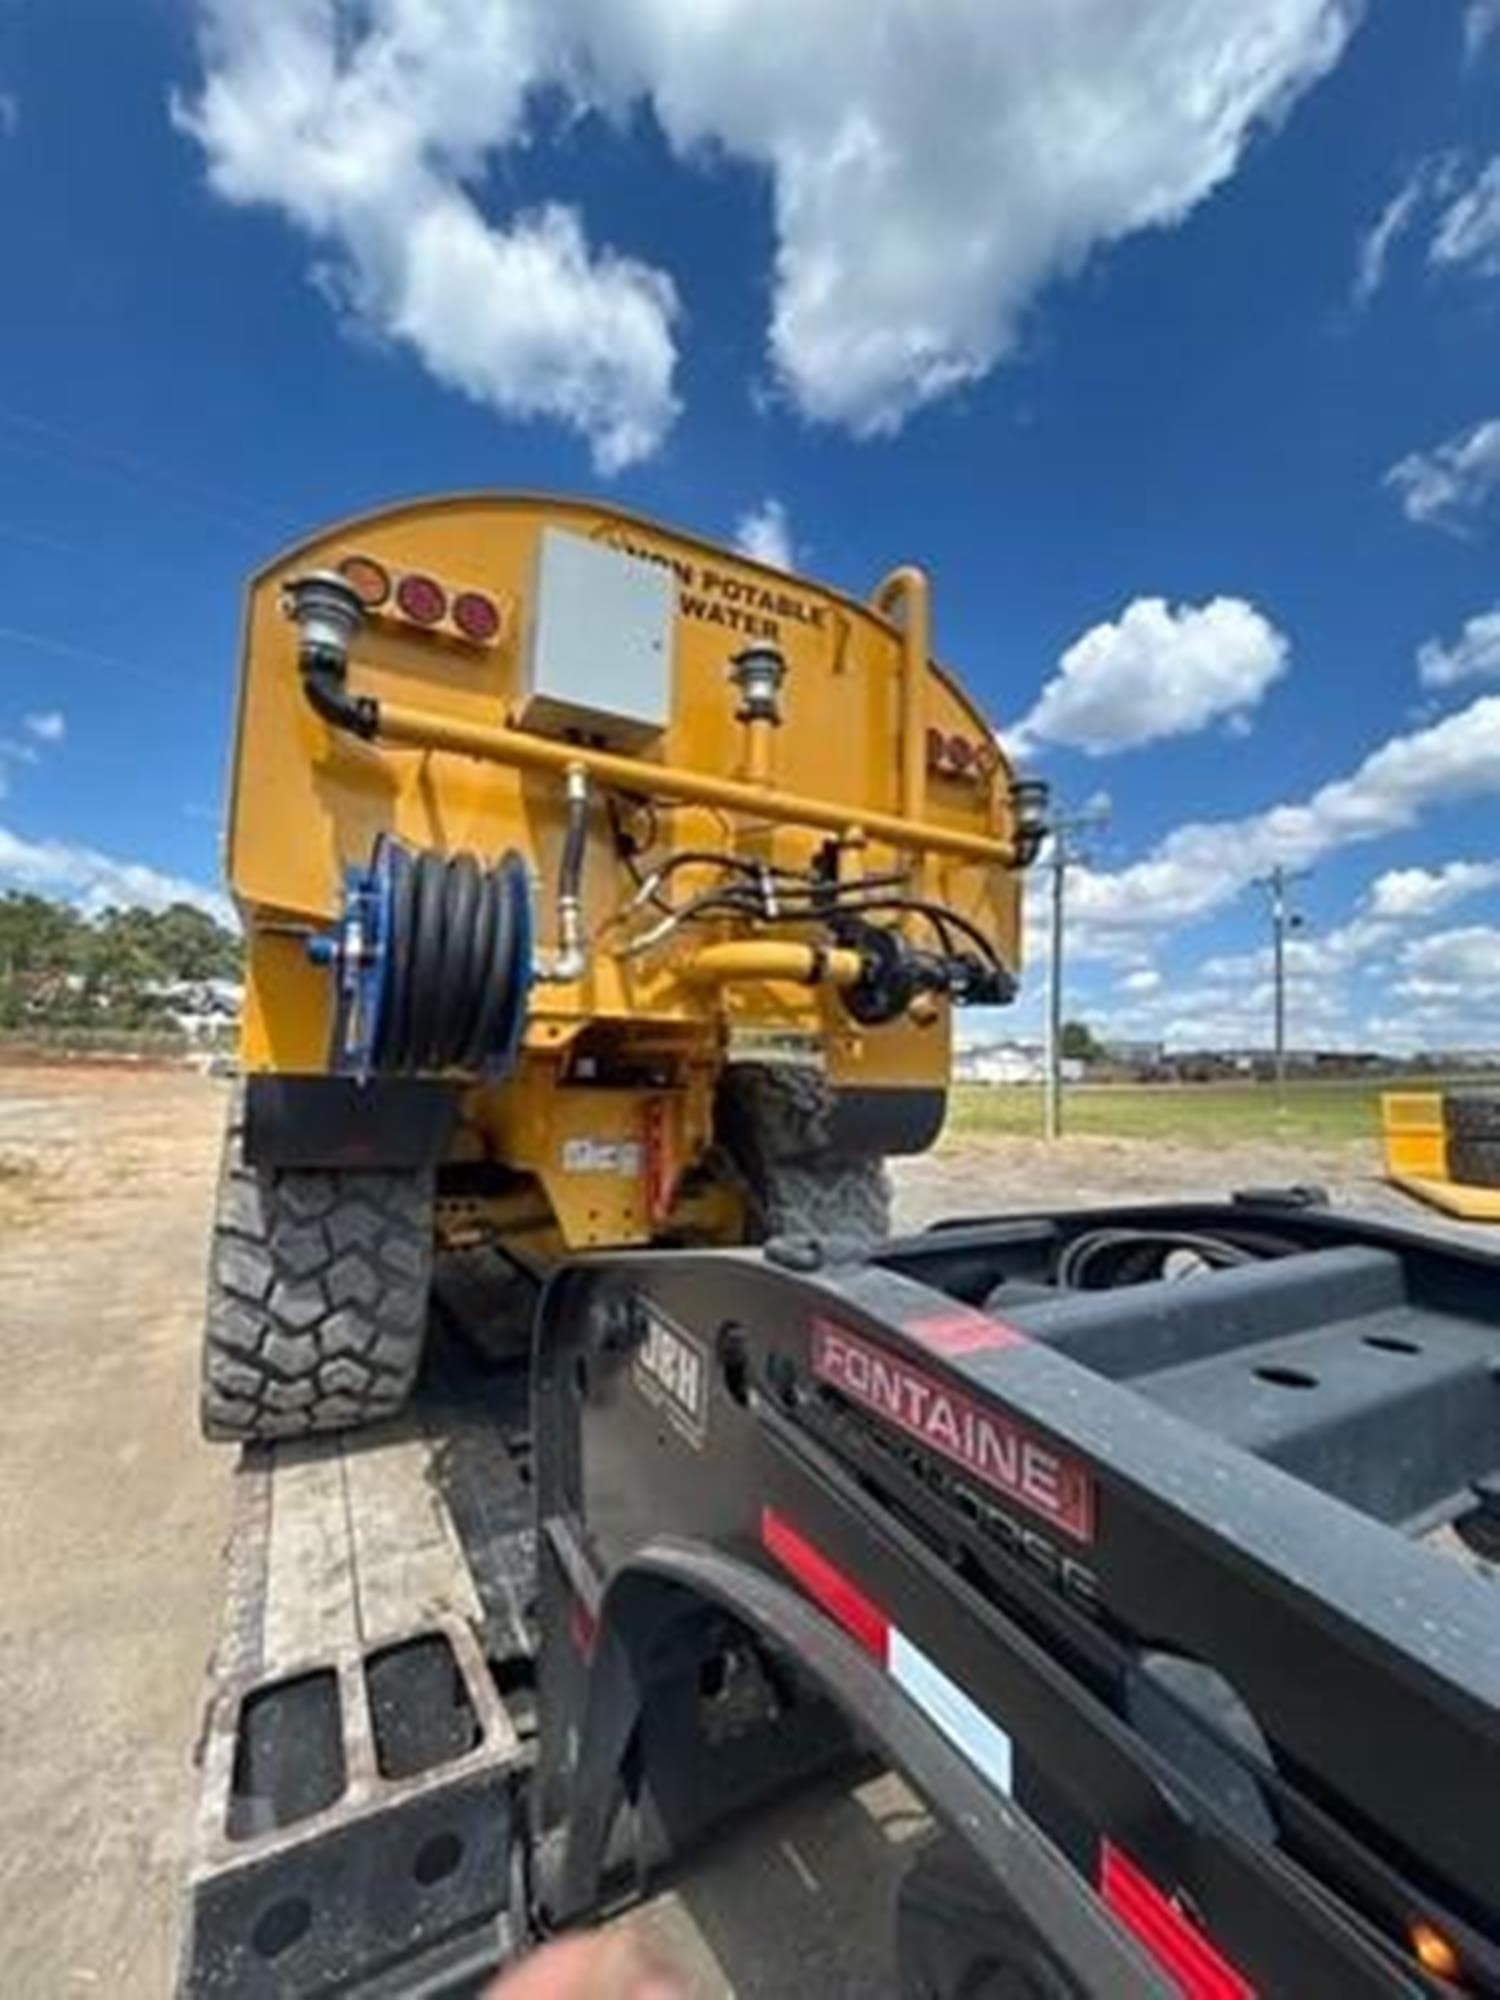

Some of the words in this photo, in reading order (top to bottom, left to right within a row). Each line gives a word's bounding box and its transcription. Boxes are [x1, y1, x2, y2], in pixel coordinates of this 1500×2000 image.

[679, 592, 779, 639] WATER
[702, 570, 825, 629] POTABLE
[821, 1336, 1060, 1510] FONTAINE
